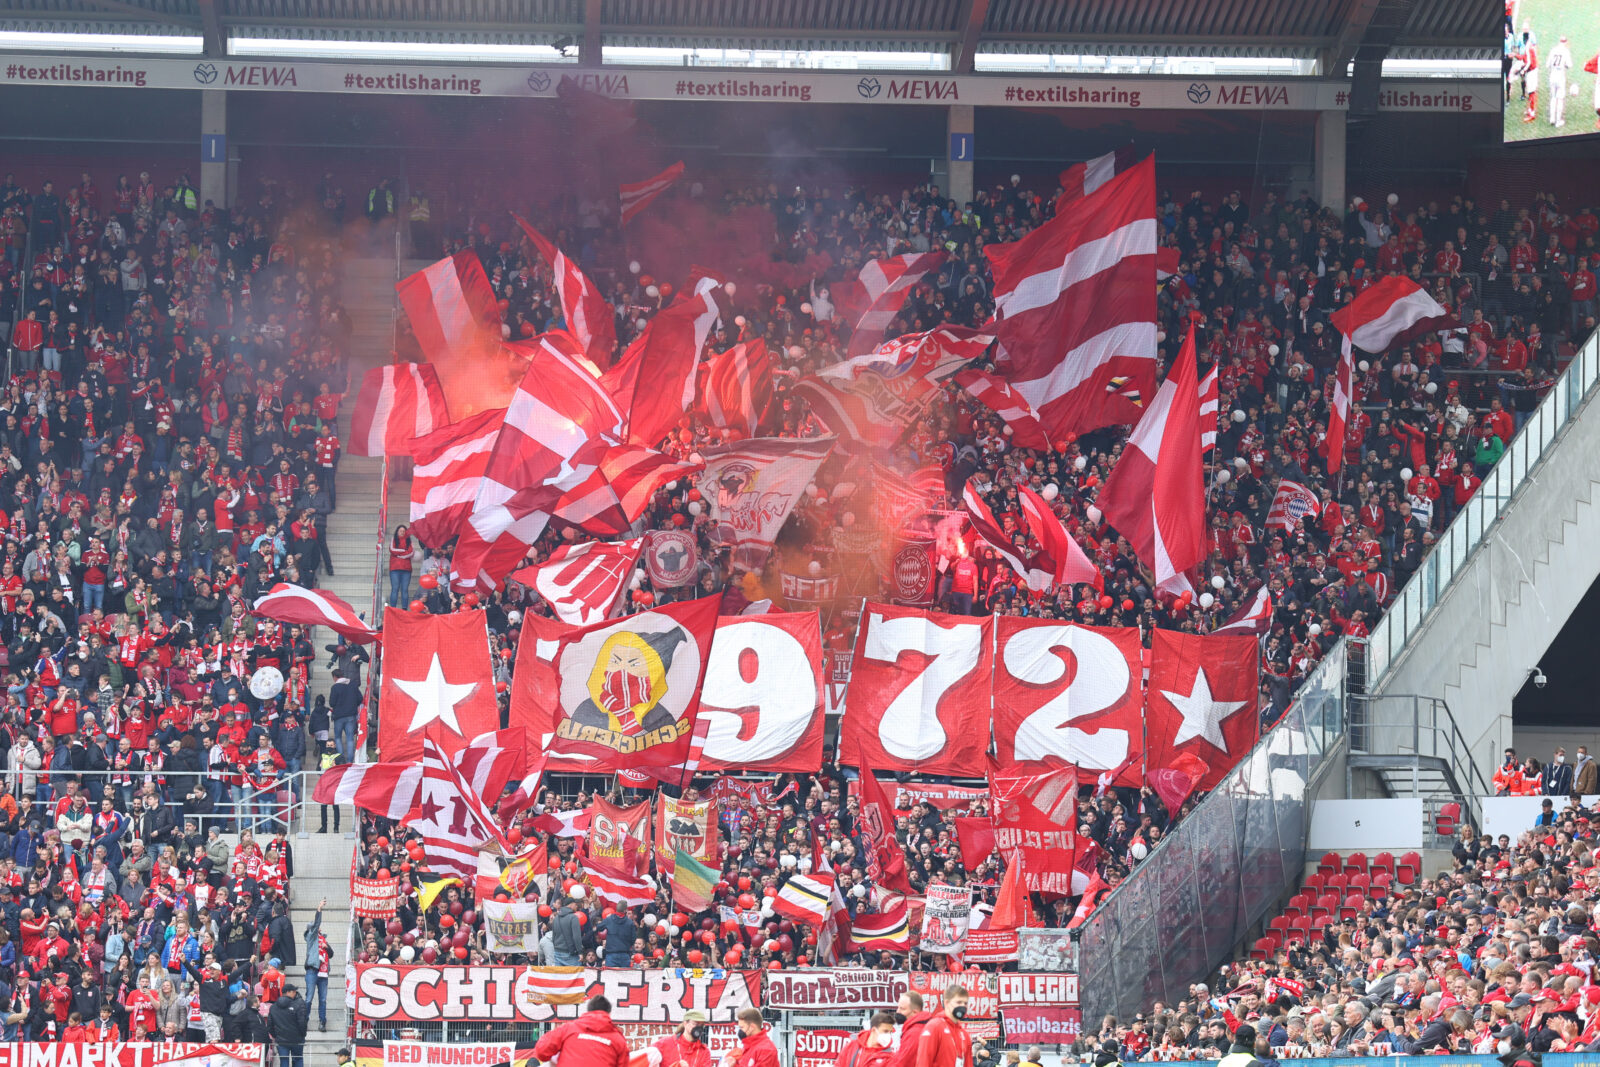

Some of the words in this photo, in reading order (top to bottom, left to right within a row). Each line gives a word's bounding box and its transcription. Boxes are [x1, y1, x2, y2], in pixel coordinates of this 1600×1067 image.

[6, 64, 147, 87] #textilsharing
[224, 66, 298, 86] MEWA
[344, 73, 482, 95] #textilsharing
[675, 80, 812, 101] #textilsharing
[887, 80, 959, 99] MEWA
[1005, 86, 1141, 107] #textilsharing
[1217, 85, 1289, 105] MEWA
[958, 138, 966, 159] J
[594, 813, 648, 850] SM
[834, 971, 874, 983] Sektion
[357, 966, 759, 1021] SCHICERIA
[1000, 976, 1079, 1003] COLEGIO
[921, 993, 939, 1014] ED
[966, 996, 998, 1018] RIDE
[388, 1044, 422, 1064] RED
